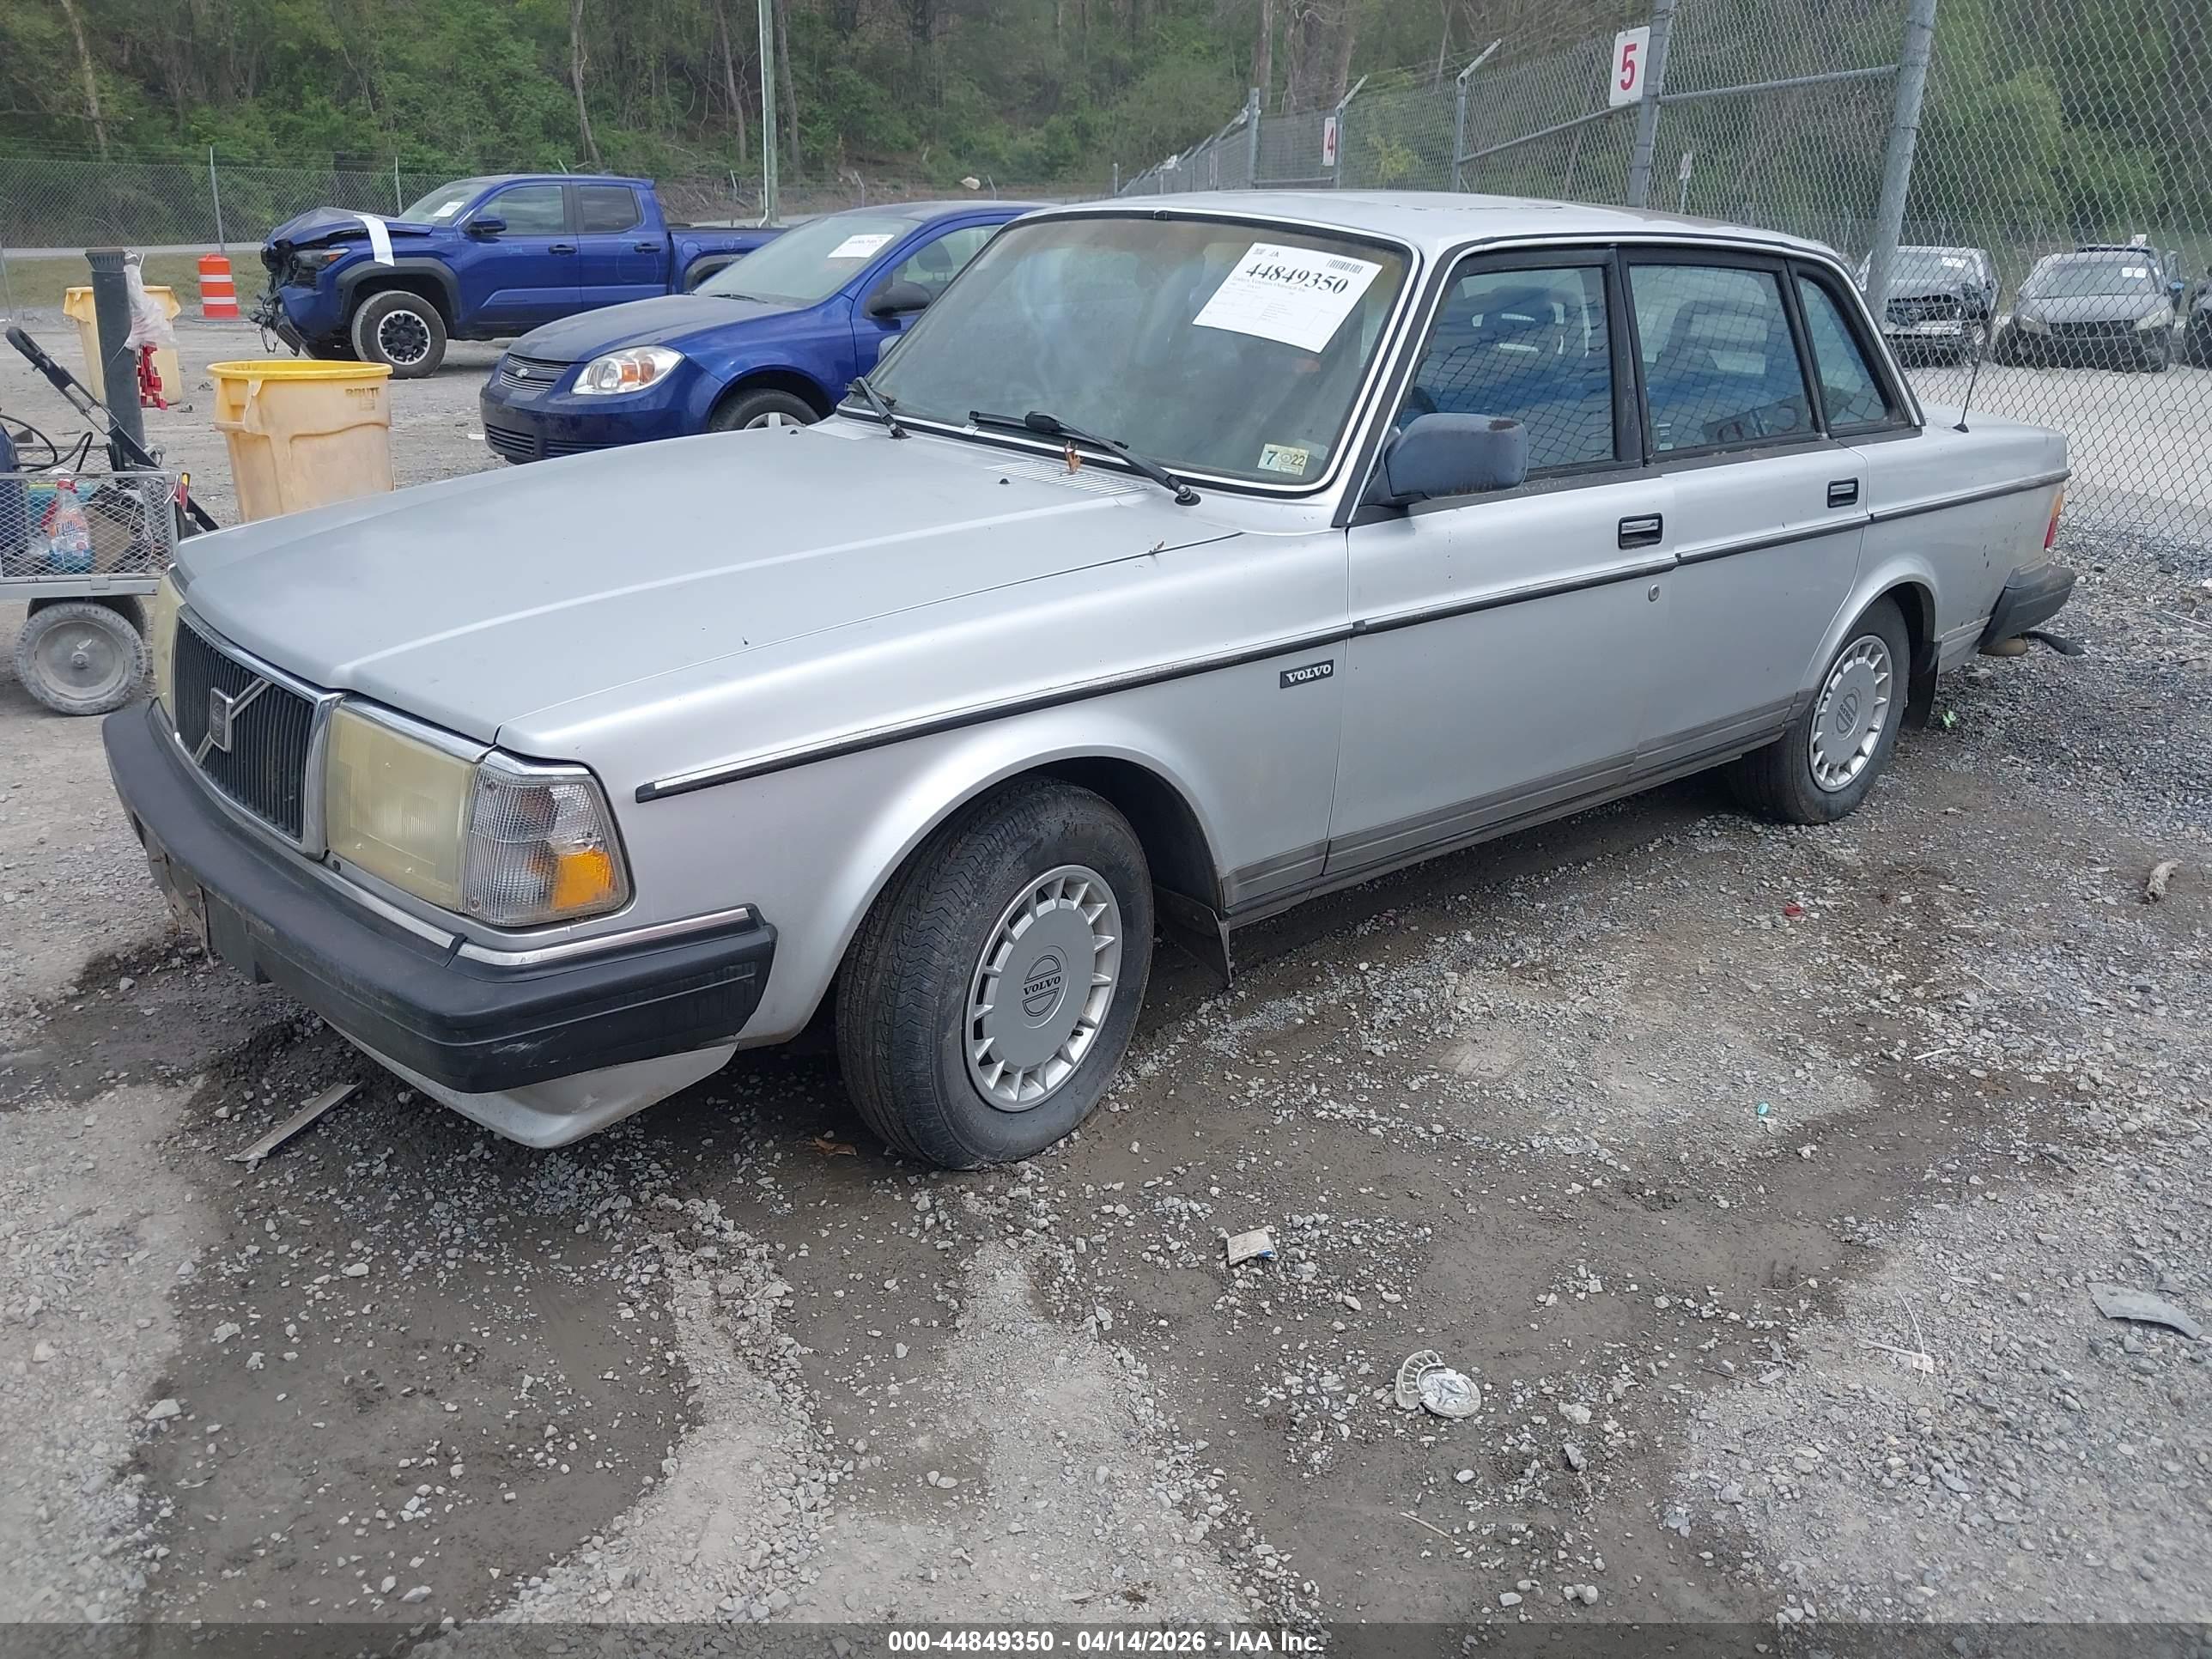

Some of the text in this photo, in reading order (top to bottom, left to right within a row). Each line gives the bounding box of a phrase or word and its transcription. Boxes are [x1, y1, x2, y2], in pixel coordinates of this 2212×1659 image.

[1620, 43, 1637, 91] 5
[1327, 126, 1334, 157] 4
[1245, 262, 1349, 295] 44849350
[1267, 450, 1305, 467] 7 22
[1285, 664, 1332, 684] VOLVO
[1023, 975, 1061, 995] VOLVO
